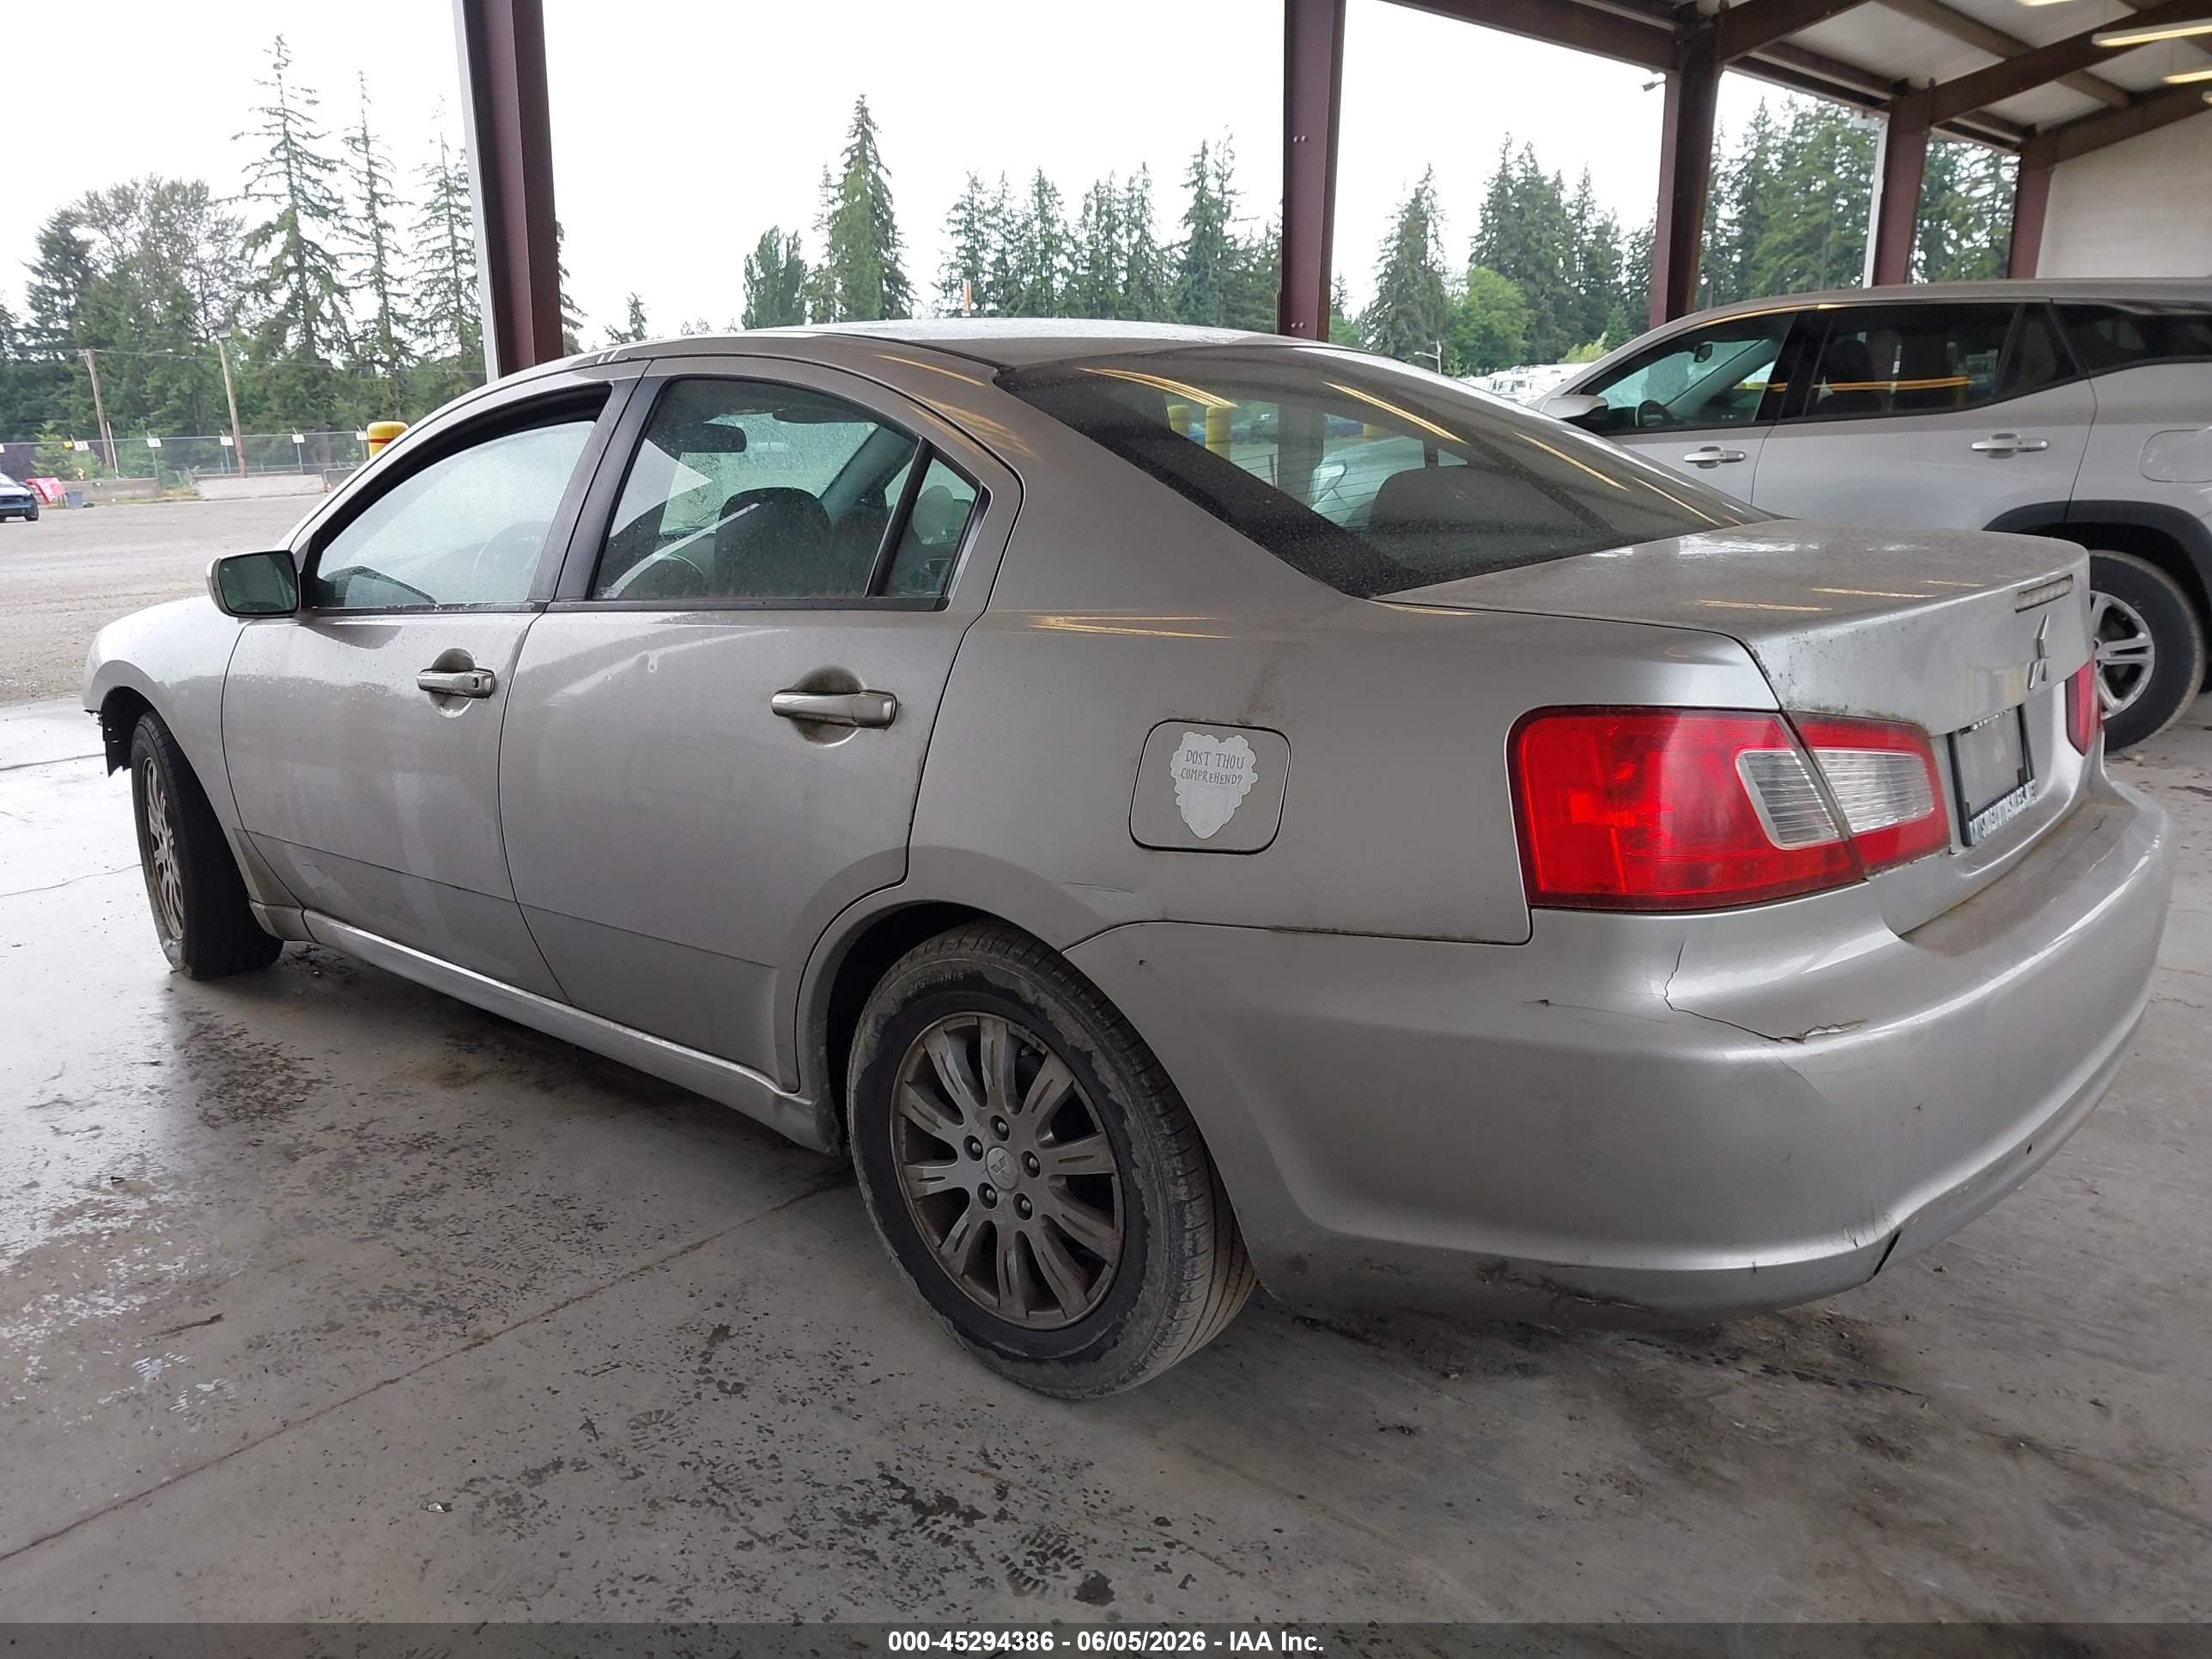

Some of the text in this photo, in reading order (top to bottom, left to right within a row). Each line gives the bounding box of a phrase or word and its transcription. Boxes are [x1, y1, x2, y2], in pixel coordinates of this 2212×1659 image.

[1185, 749, 1245, 769] DOST THOU
[1181, 768, 1243, 788] COMPREHEND?
